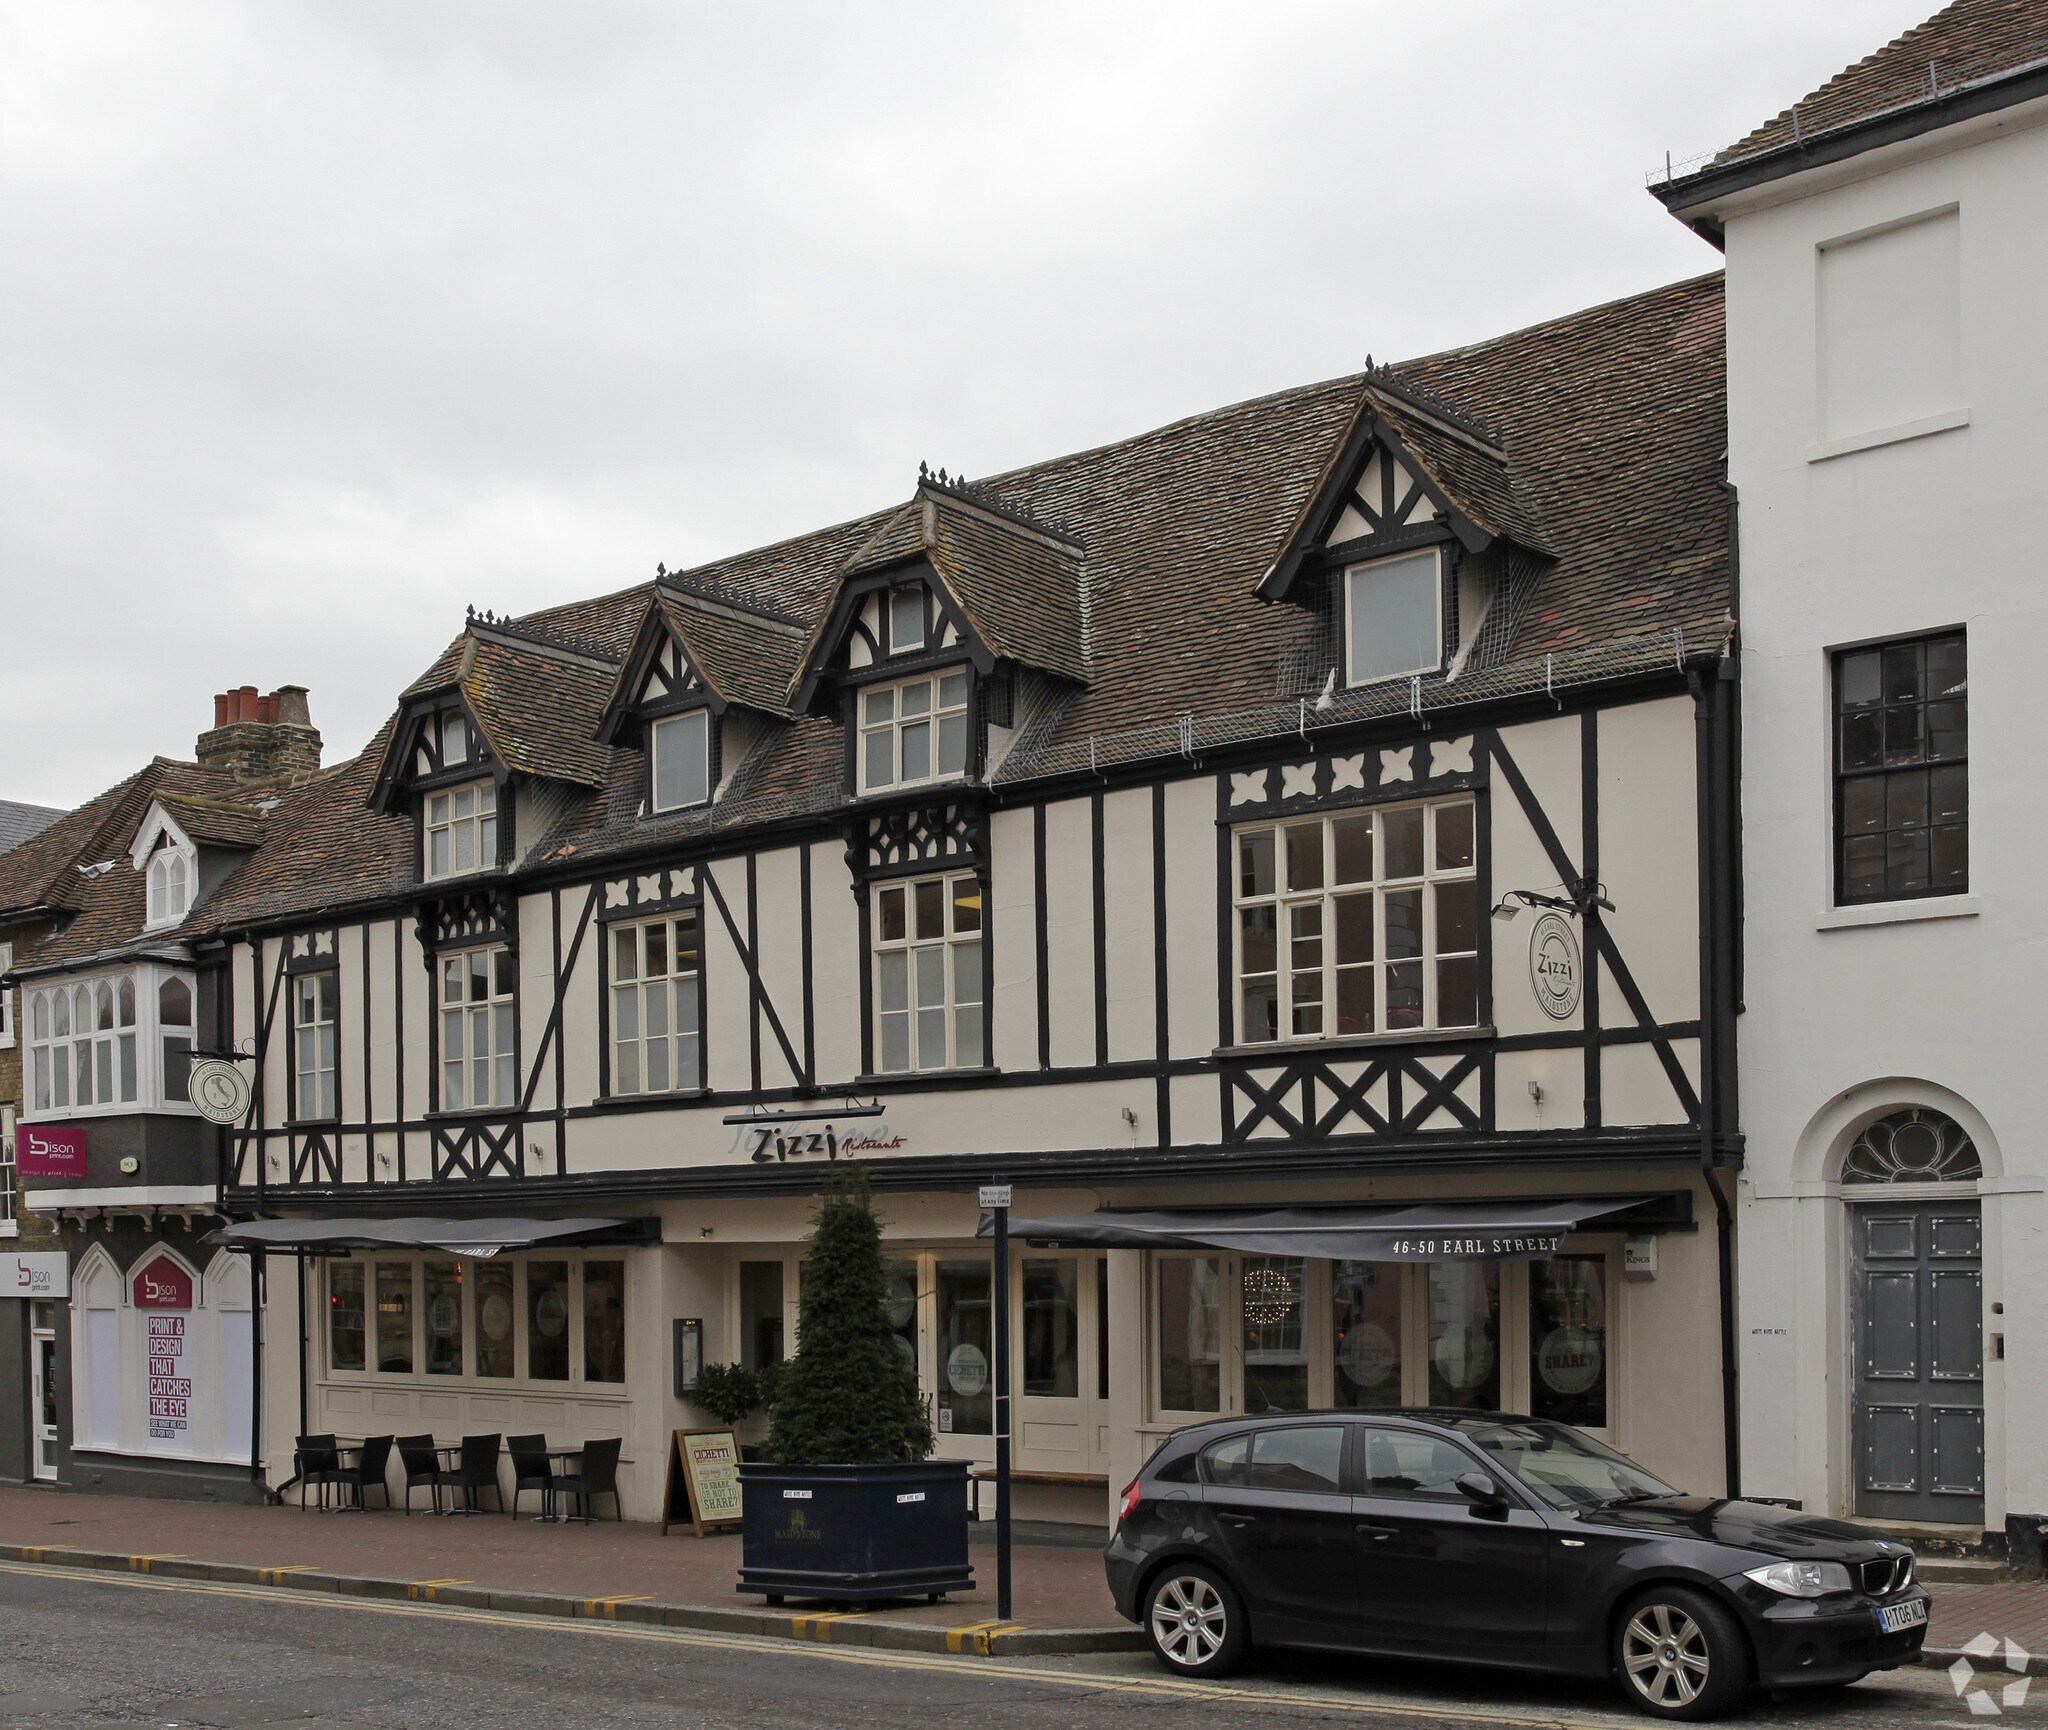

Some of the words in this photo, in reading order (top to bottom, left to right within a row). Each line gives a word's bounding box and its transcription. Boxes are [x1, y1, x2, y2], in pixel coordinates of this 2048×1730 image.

[1538, 953, 1572, 980] Zizzi
[1540, 987, 1574, 1012] MAIDSTONE
[203, 1104, 241, 1118] MAIDSTONE
[29, 1133, 74, 1155] bison
[751, 1123, 837, 1162] Zizzi
[49, 1152, 74, 1160] print.com
[1393, 1240, 1435, 1253] 46-50
[1443, 1240, 1485, 1253] EARL
[1493, 1237, 1558, 1252] STREET
[18, 1258, 50, 1286] bison
[145, 1274, 176, 1298] bison
[149, 1318, 174, 1334] PRINT
[176, 1317, 183, 1335] &
[150, 1338, 181, 1355] DESIGN
[150, 1358, 173, 1375] THAT
[1545, 1353, 1594, 1369] SHARE?
[150, 1378, 190, 1396] CATCHES
[151, 1398, 168, 1415] THE
[169, 1400, 186, 1416] EYE
[702, 1489, 712, 1499] OR
[712, 1488, 727, 1498] NOT
[729, 1487, 737, 1496] TO
[704, 1496, 739, 1510] SHARE?
